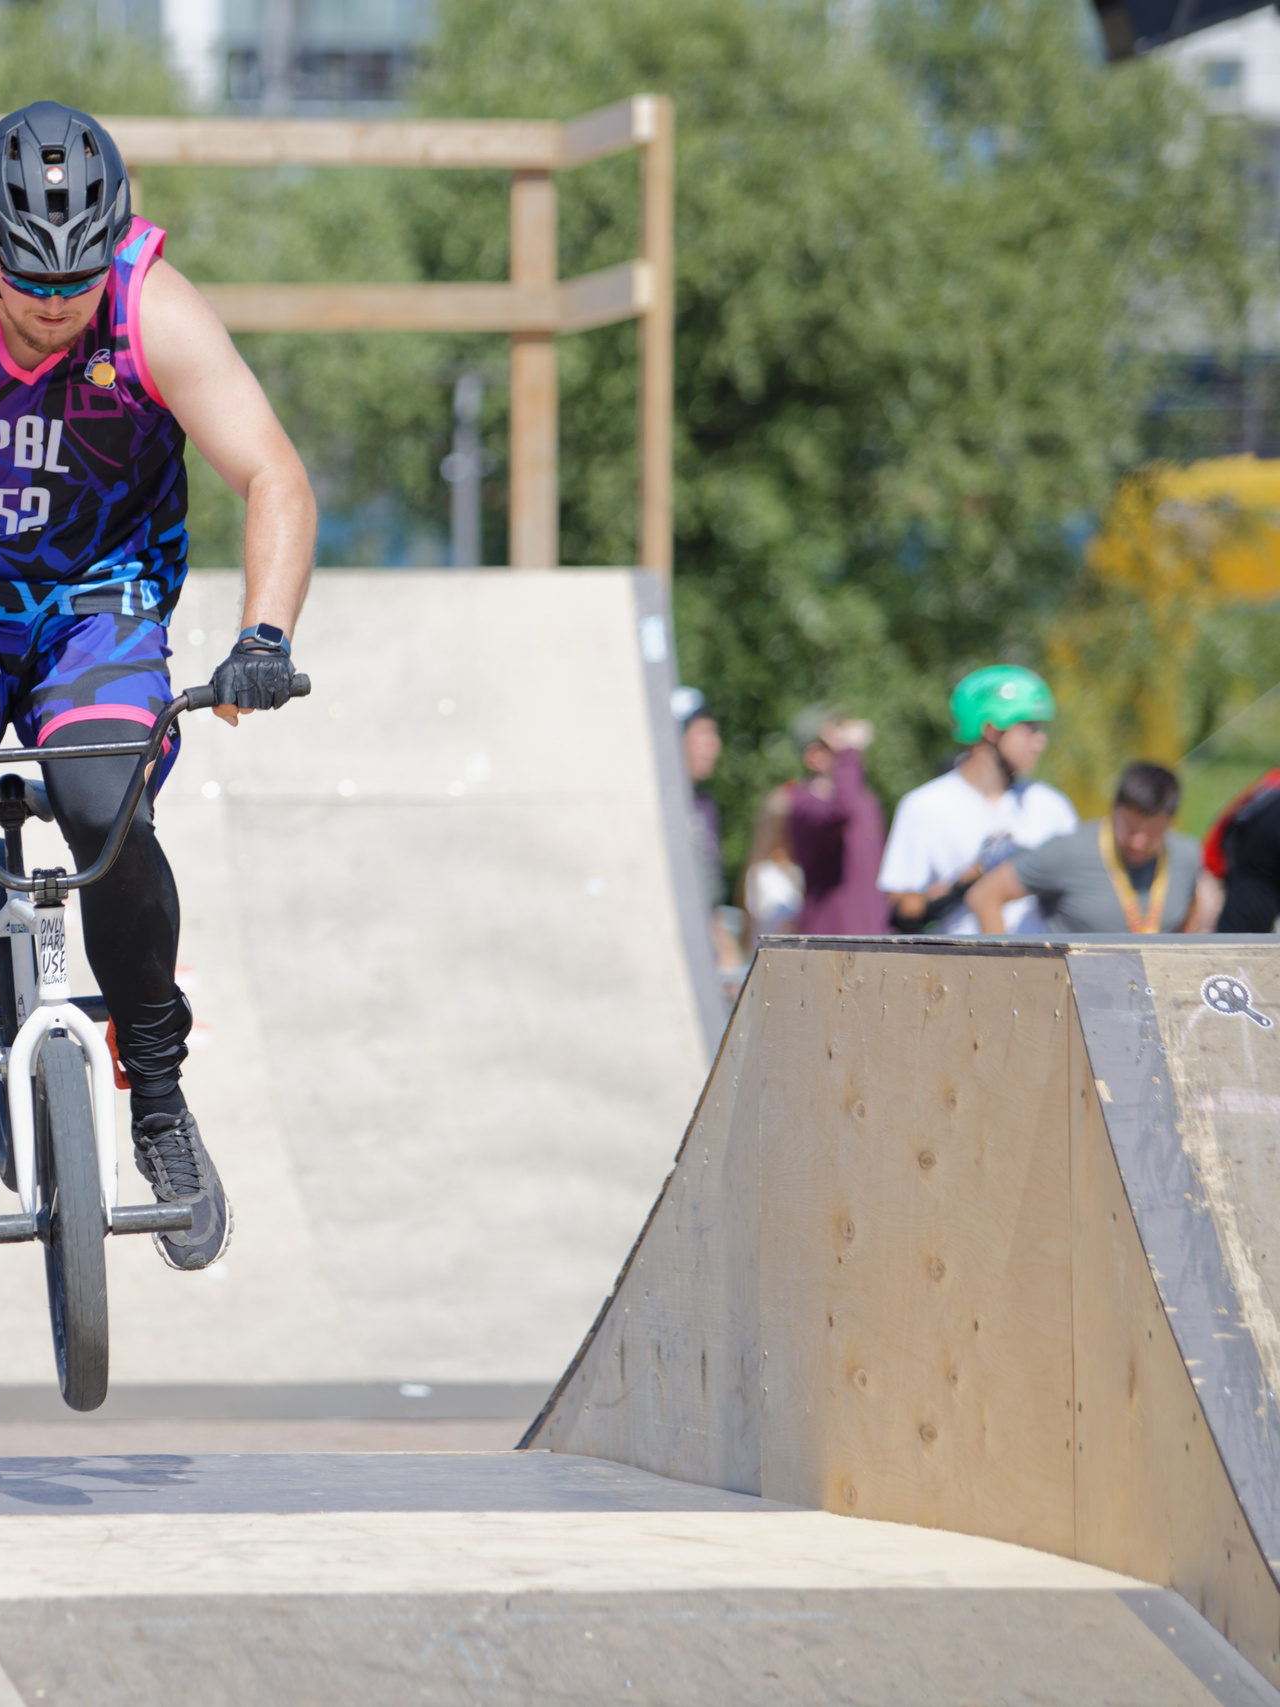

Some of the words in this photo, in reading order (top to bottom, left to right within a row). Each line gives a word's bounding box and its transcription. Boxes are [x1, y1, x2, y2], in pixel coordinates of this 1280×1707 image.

[41, 917, 64, 934] ONLY
[40, 934, 65, 951] HARD
[42, 951, 65, 975] USE
[42, 974, 67, 985] ALLOWED
